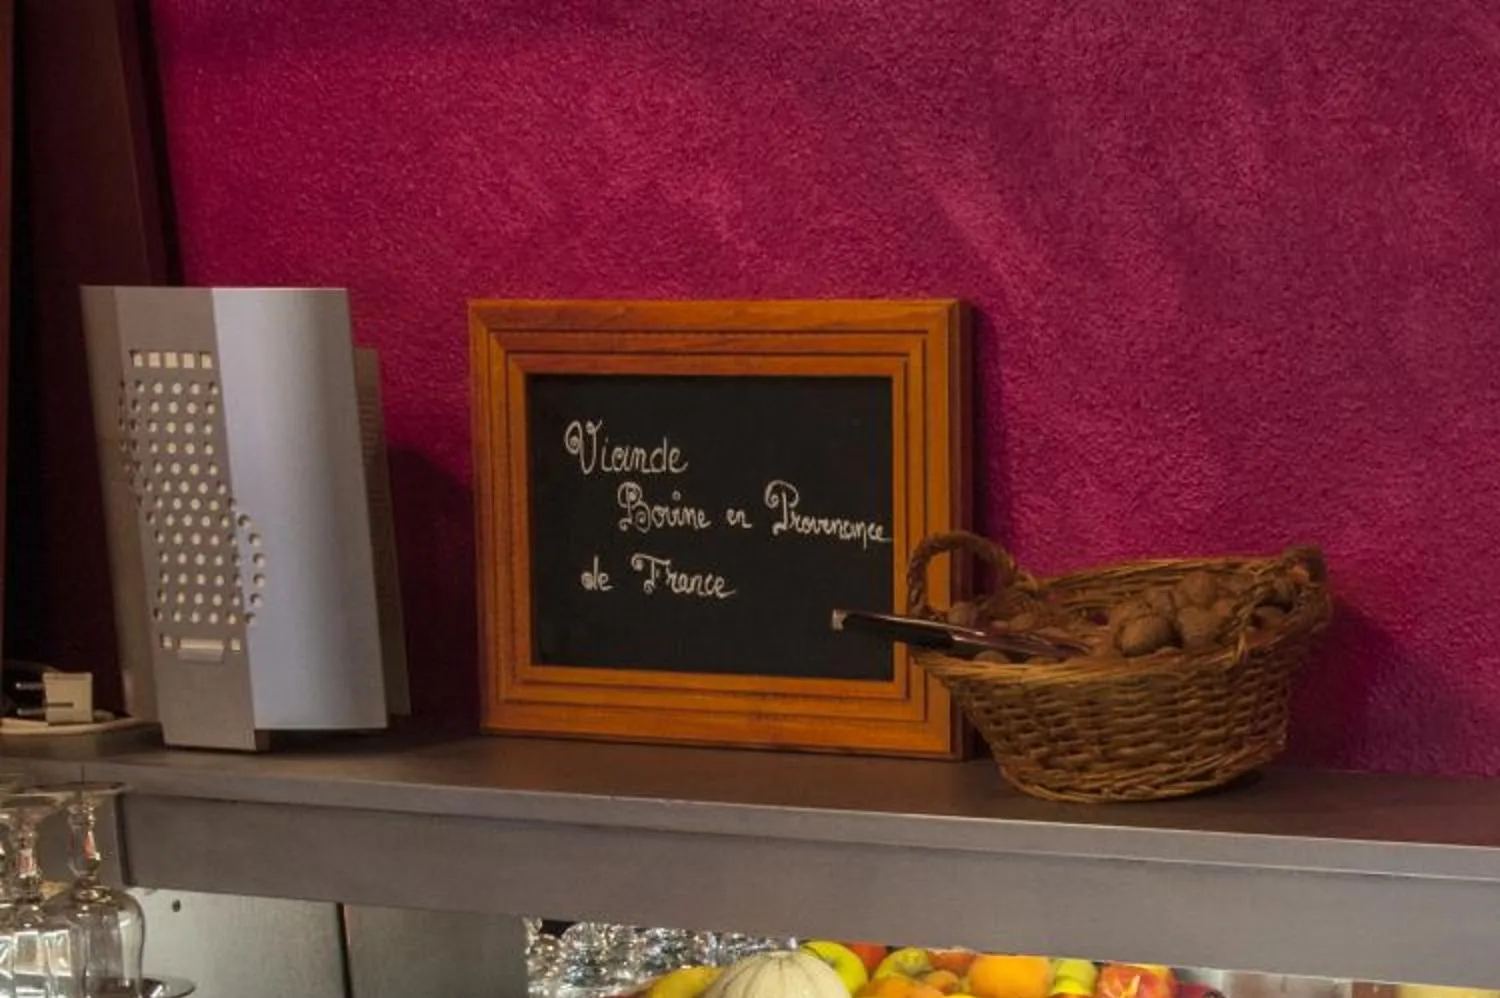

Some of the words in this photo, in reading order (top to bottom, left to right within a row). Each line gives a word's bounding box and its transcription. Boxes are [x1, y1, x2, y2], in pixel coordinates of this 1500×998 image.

[565, 420, 688, 475] Viande
[617, 481, 711, 533] Bovine
[726, 508, 752, 529] en
[764, 480, 893, 549] Provenance
[580, 556, 614, 591] de
[631, 553, 736, 598] France
